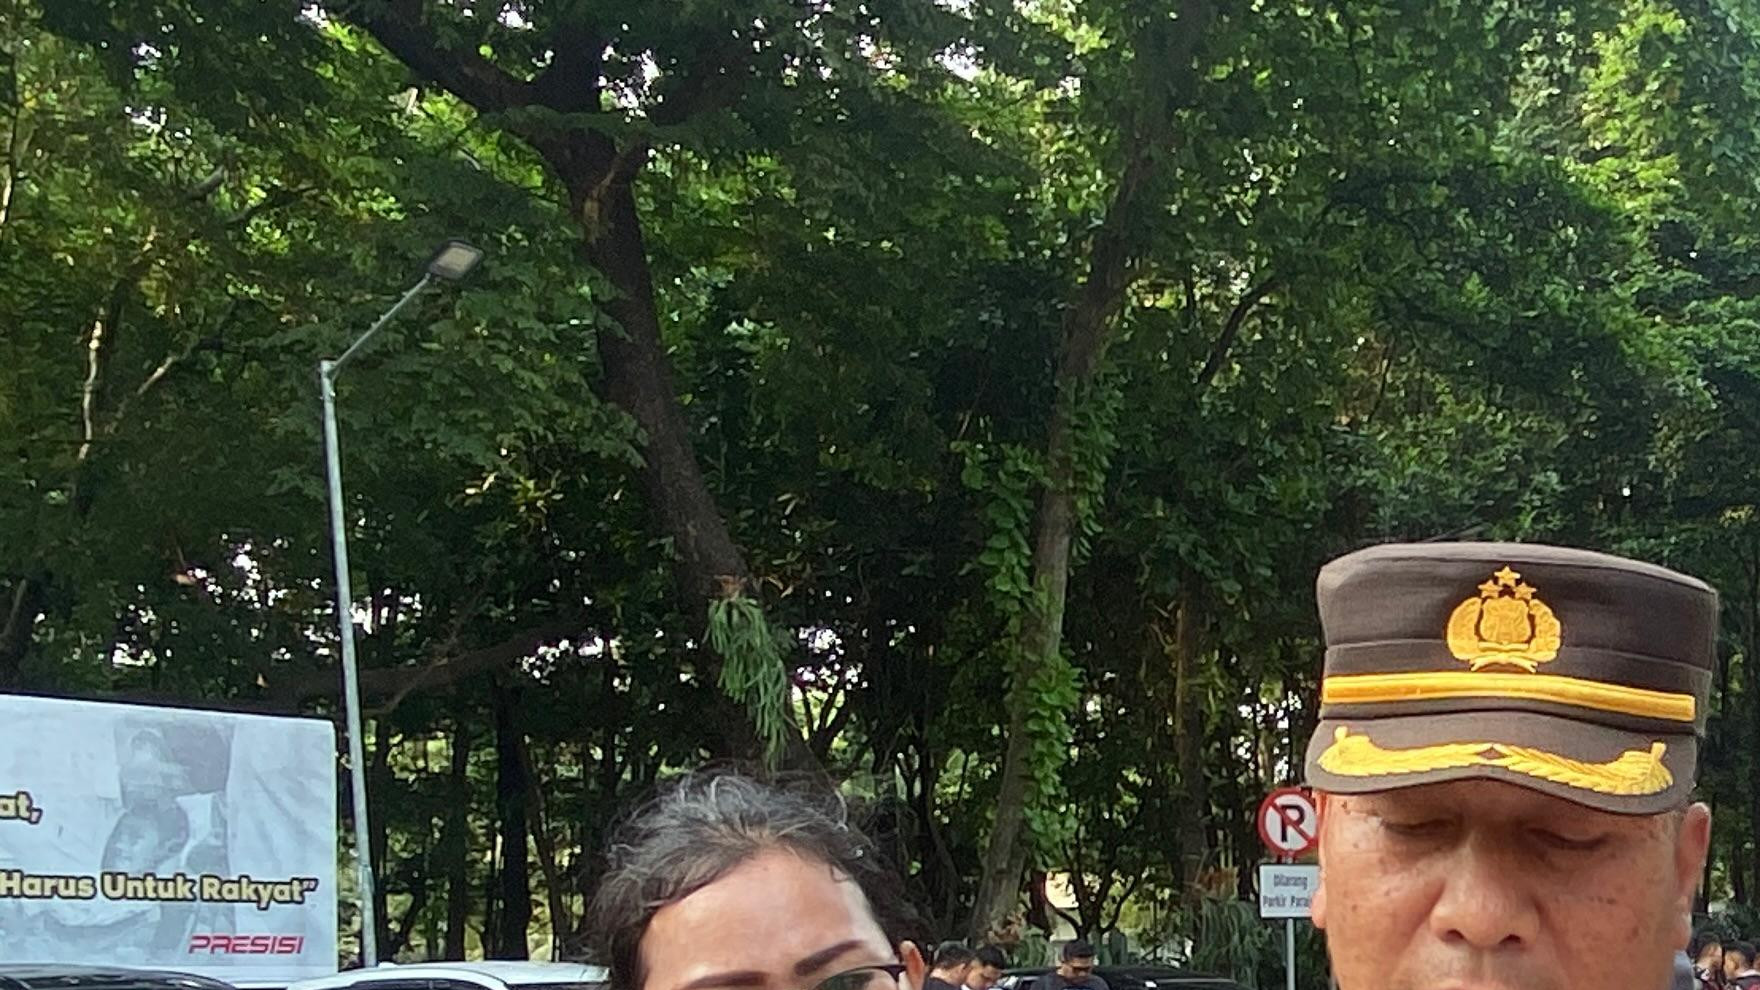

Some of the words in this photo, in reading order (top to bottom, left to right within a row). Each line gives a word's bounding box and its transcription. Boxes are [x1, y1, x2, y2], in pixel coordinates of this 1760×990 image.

[0, 869, 97, 900] Harus
[101, 871, 198, 902] Untuk
[188, 935, 304, 954] PRESISI
